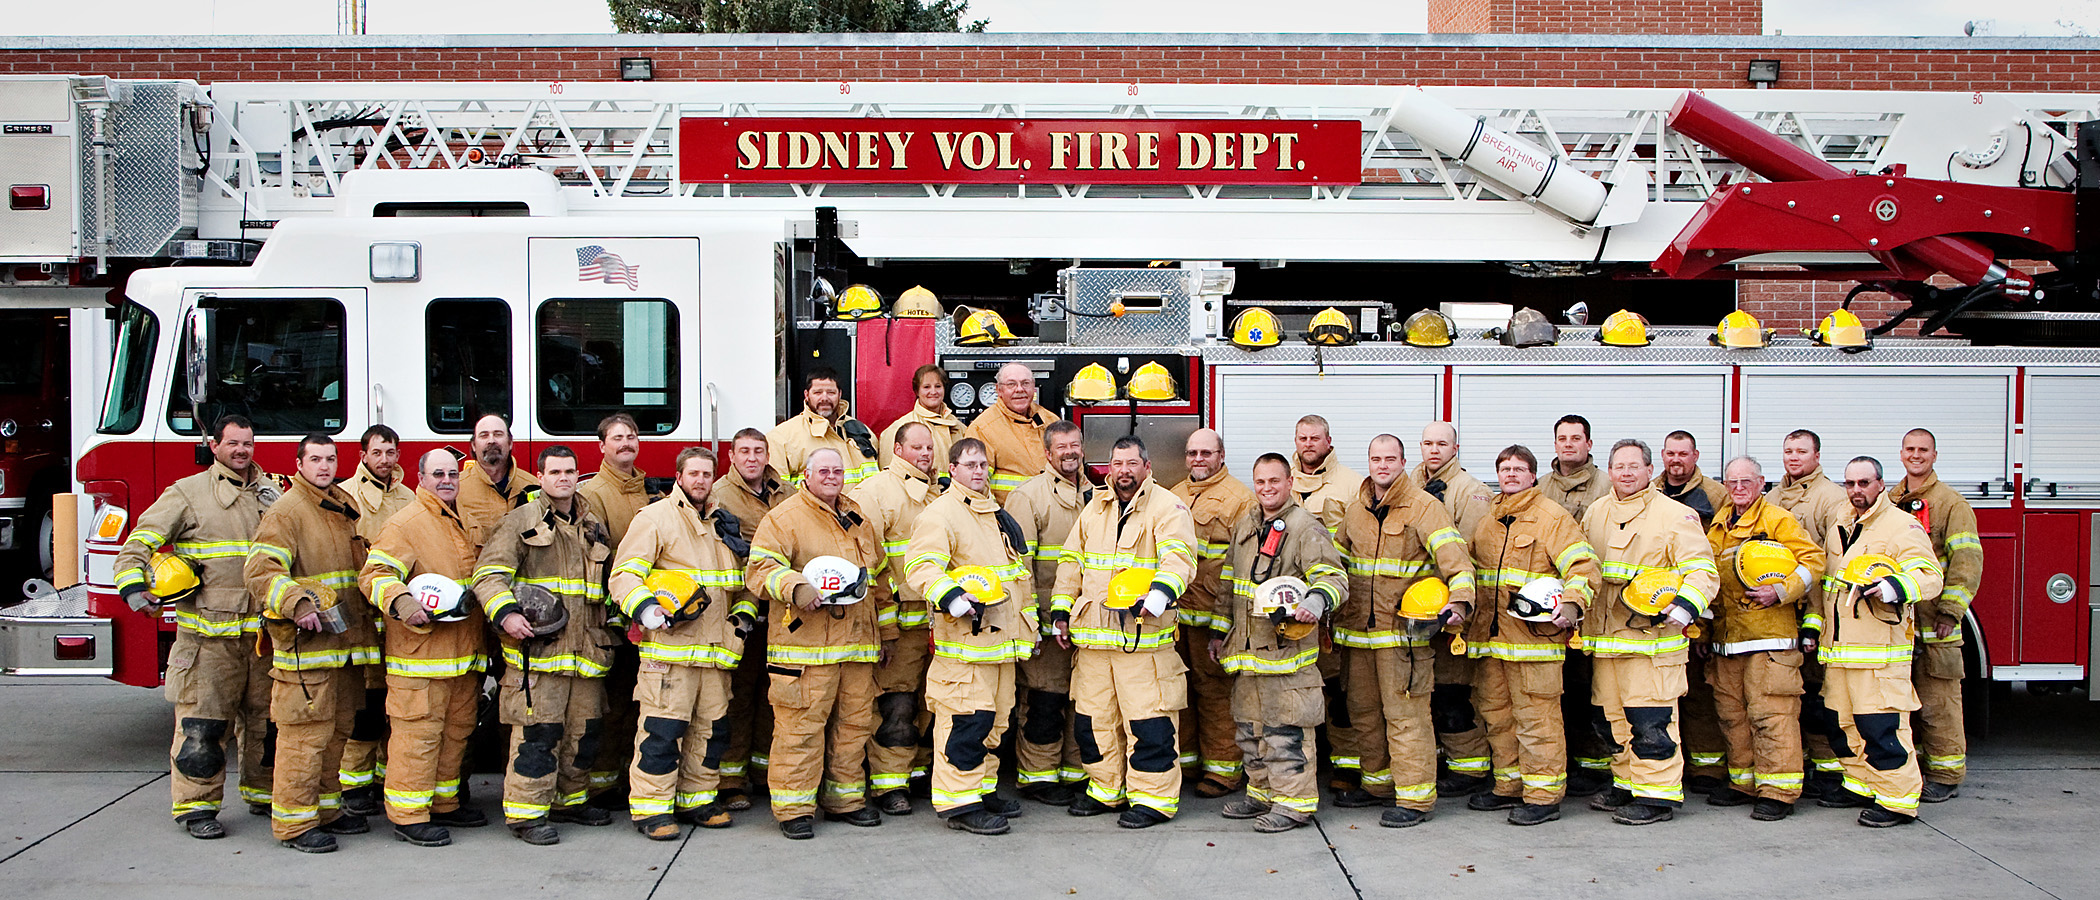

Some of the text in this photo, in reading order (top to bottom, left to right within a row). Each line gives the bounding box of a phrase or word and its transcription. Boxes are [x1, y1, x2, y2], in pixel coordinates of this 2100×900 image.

[549, 84, 563, 94] 100
[840, 84, 850, 94] 90
[1128, 86, 1138, 96] 80
[1973, 94, 1983, 104] 50
[737, 130, 1305, 170] SIDNEY VOL. FIRE DEPT.
[1481, 133, 1545, 172] BREATHING
[1496, 156, 1518, 173] AIR
[421, 585, 442, 593] CHIEF
[820, 576, 840, 590] 12
[420, 592, 440, 608] 10
